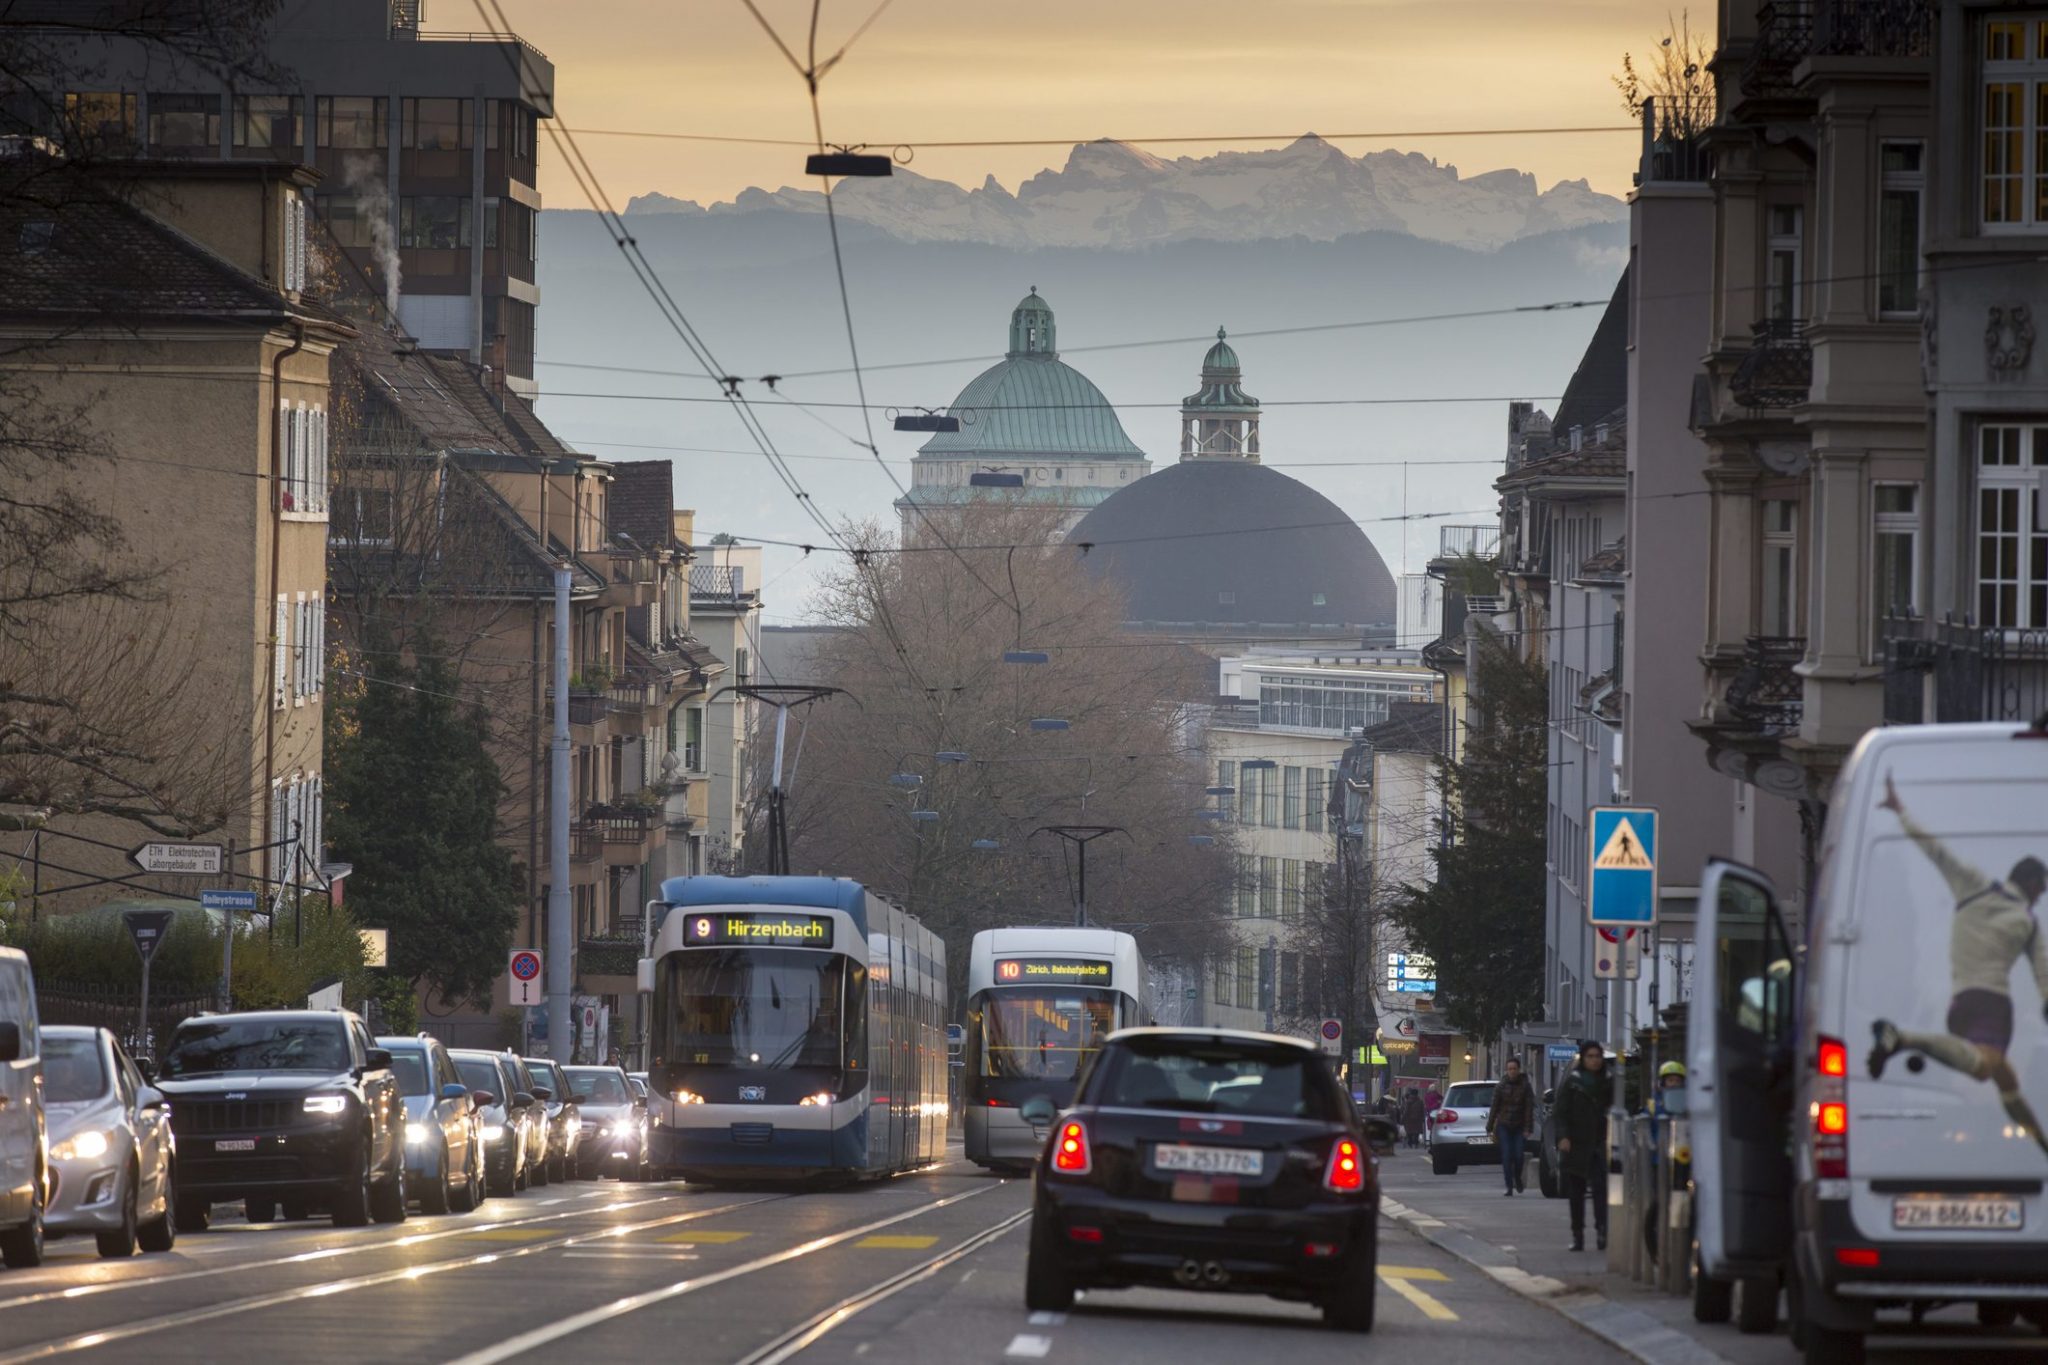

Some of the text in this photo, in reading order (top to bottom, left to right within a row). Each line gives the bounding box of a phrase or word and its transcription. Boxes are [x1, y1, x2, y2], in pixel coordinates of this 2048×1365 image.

[149, 845, 217, 858] ETH Elektrotechnik
[148, 858, 217, 871] Laborgebäude ETL
[696, 918, 823, 937] 9 Hirzenbach
[1001, 962, 1019, 978] 10
[1169, 1149, 1188, 1166] ZH
[1908, 1204, 1932, 1222] ZH
